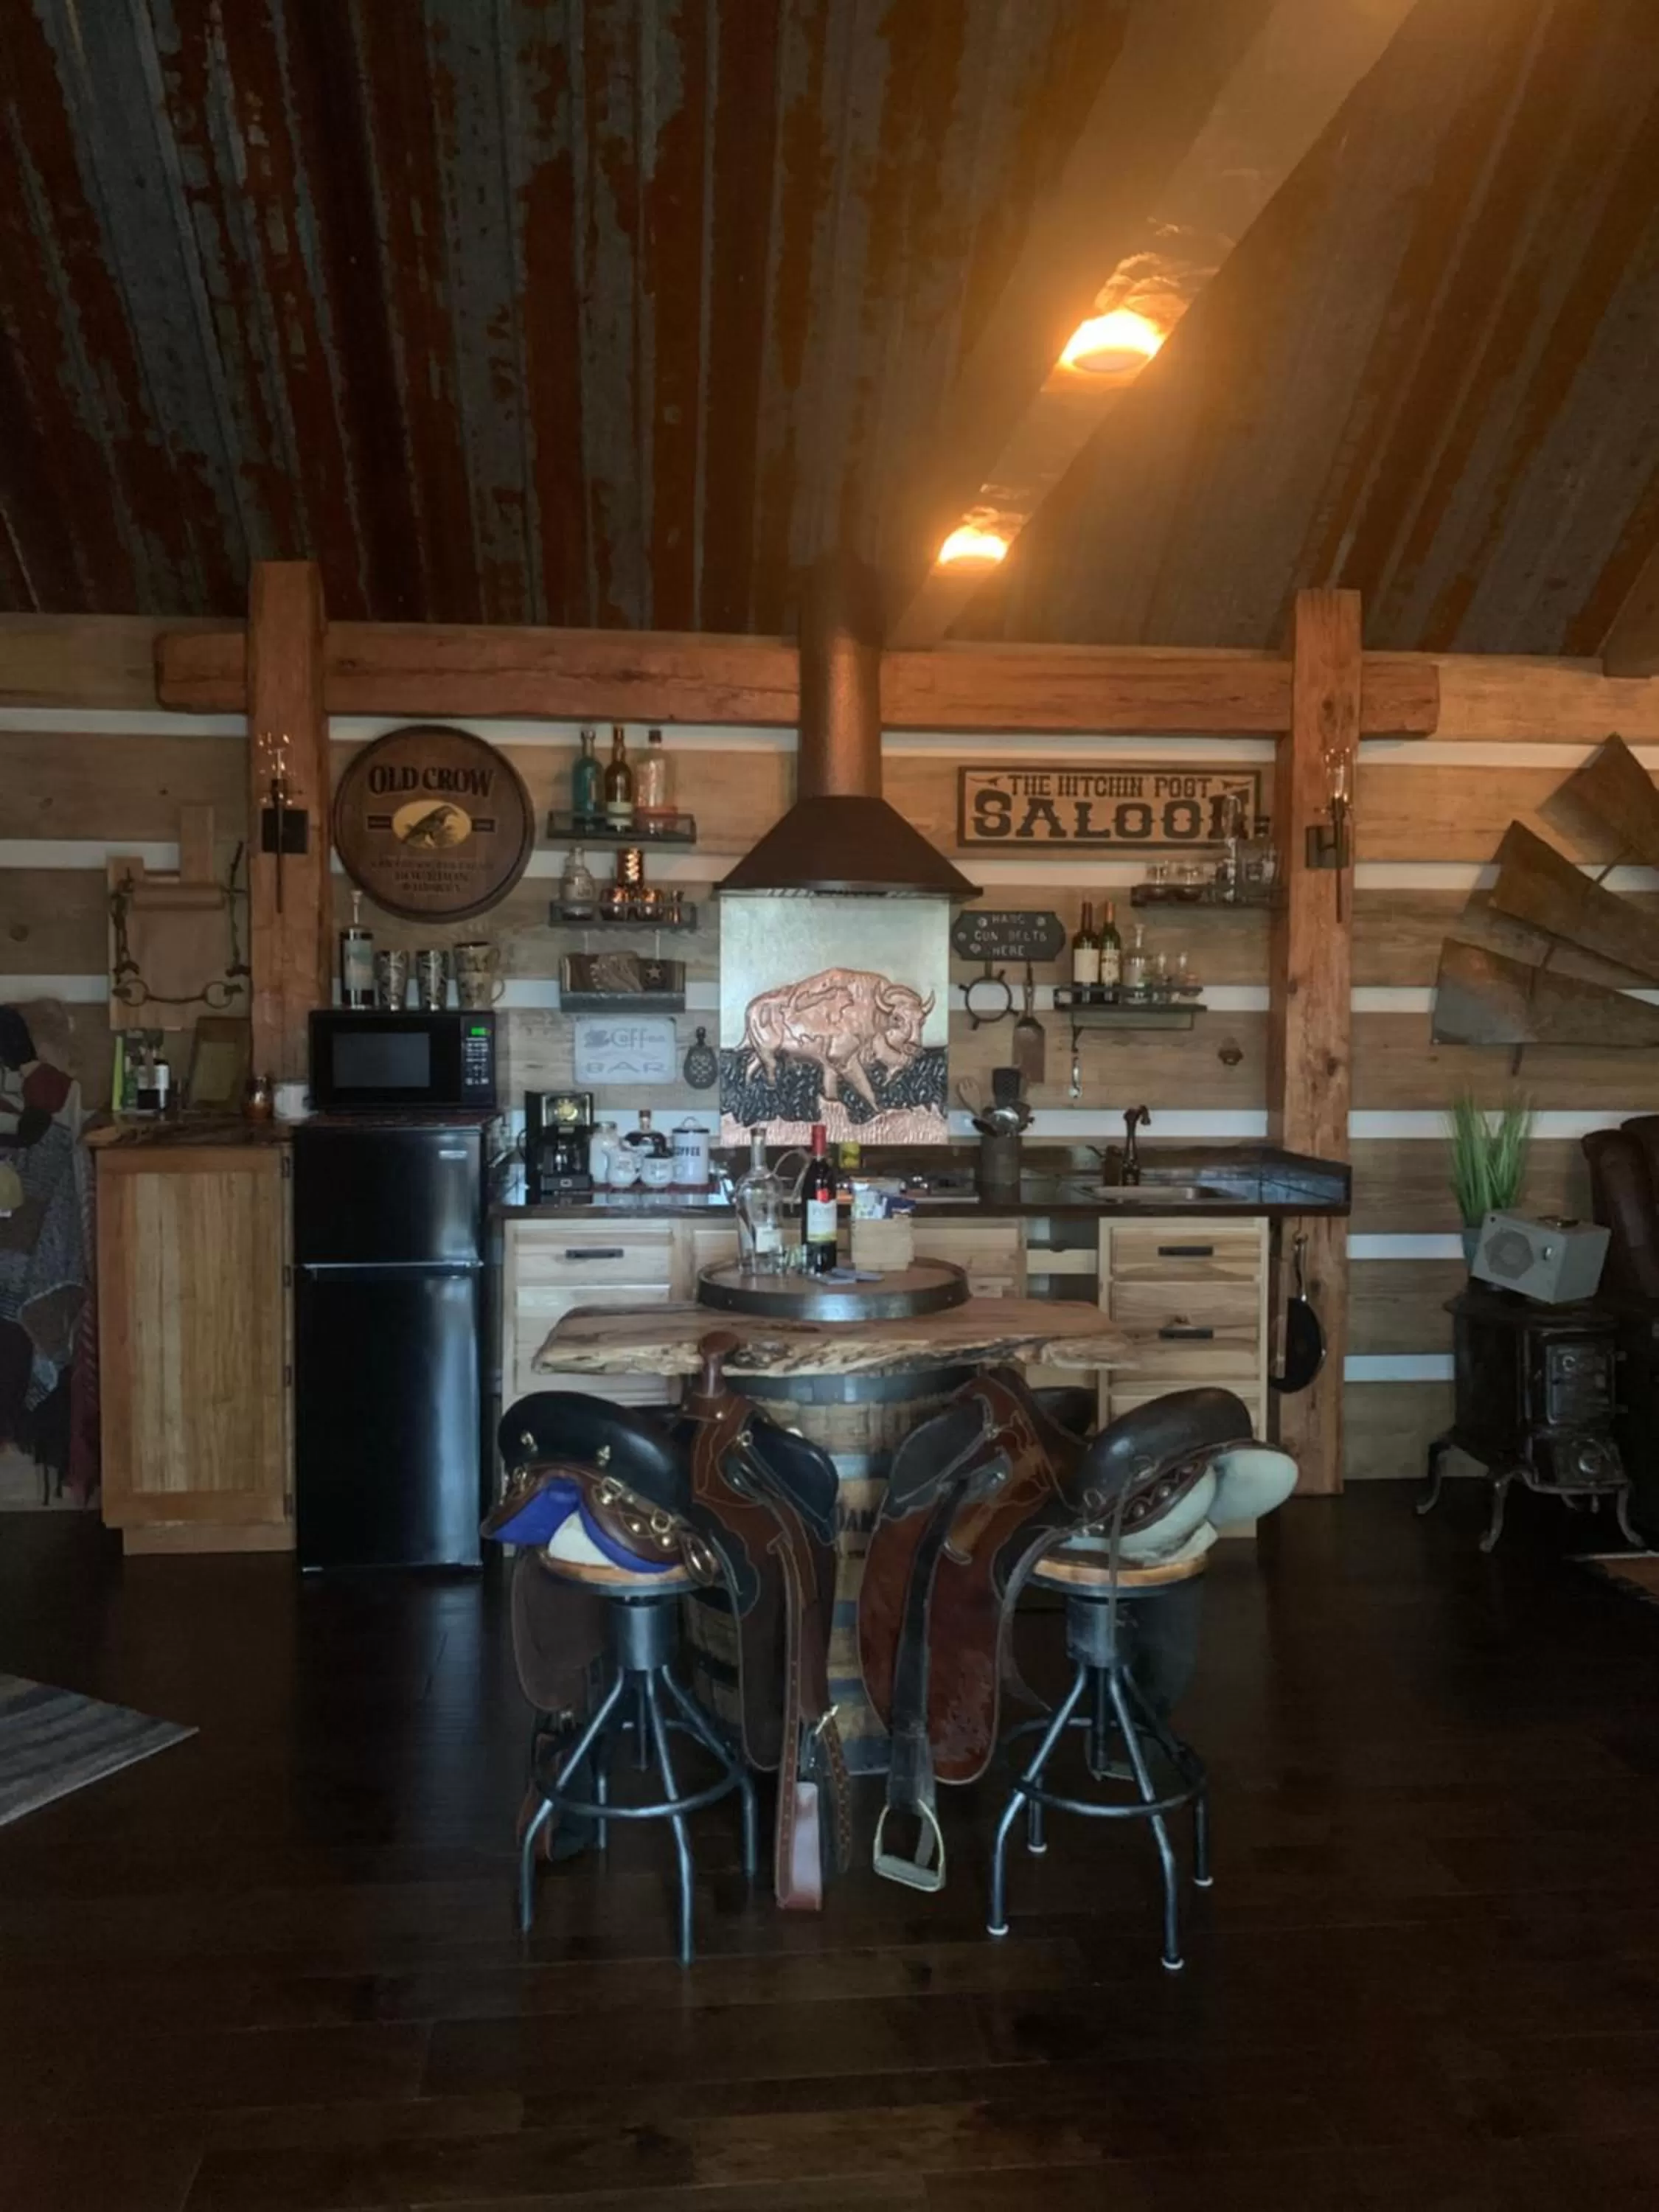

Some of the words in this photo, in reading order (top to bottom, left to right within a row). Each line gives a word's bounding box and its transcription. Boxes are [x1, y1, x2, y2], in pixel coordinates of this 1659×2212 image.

[369, 765, 419, 794] OLD
[422, 766, 493, 798] CROW
[1007, 775, 1051, 796] THE
[1154, 776, 1212, 799] POST
[971, 787, 1250, 840] SALOON
[586, 1061, 667, 1074] BAR
